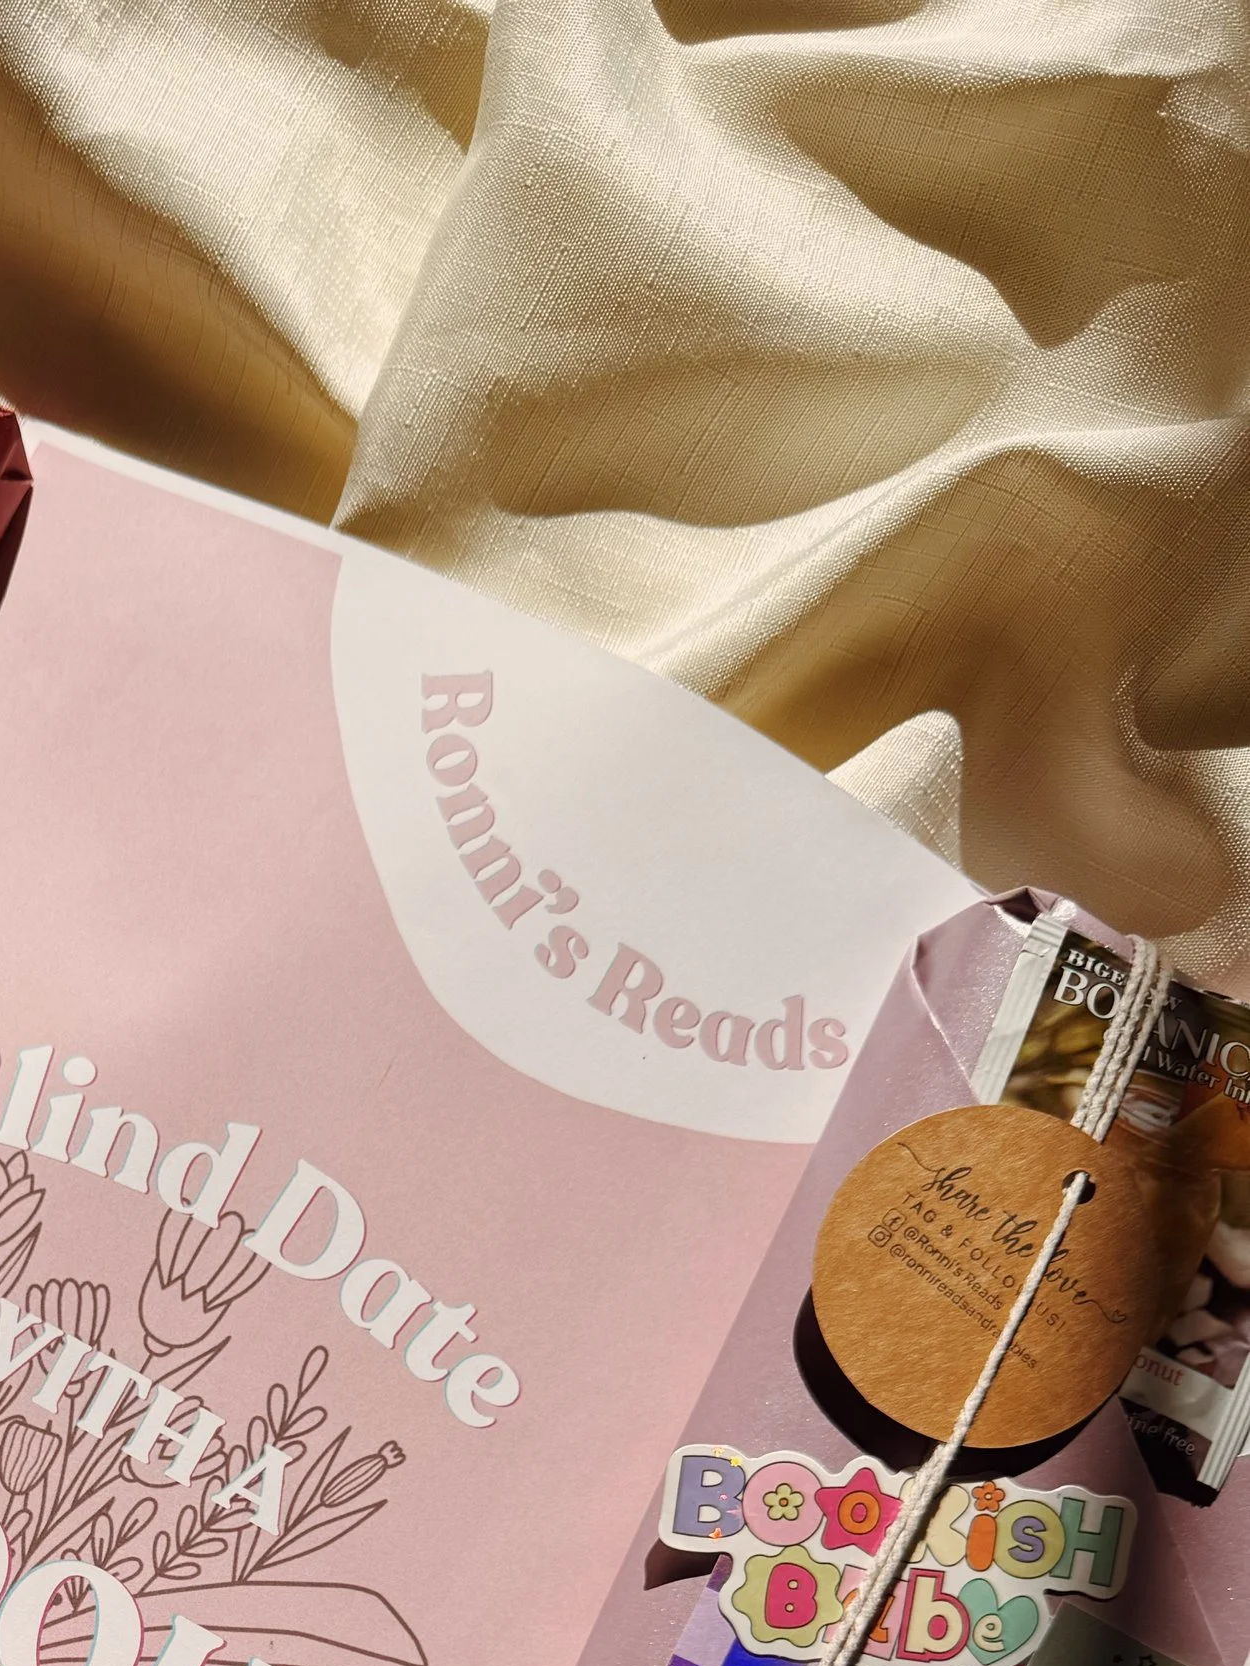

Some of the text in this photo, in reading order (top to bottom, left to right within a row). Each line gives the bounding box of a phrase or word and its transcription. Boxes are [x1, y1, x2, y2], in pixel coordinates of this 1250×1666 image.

[420, 669, 850, 1071] Ronni's Reads
[921, 1166, 1035, 1259] share the
[243, 1158, 521, 1429] Date
[904, 1224, 1006, 1312] @Ronni's Reads
[211, 1442, 295, 1537] A
